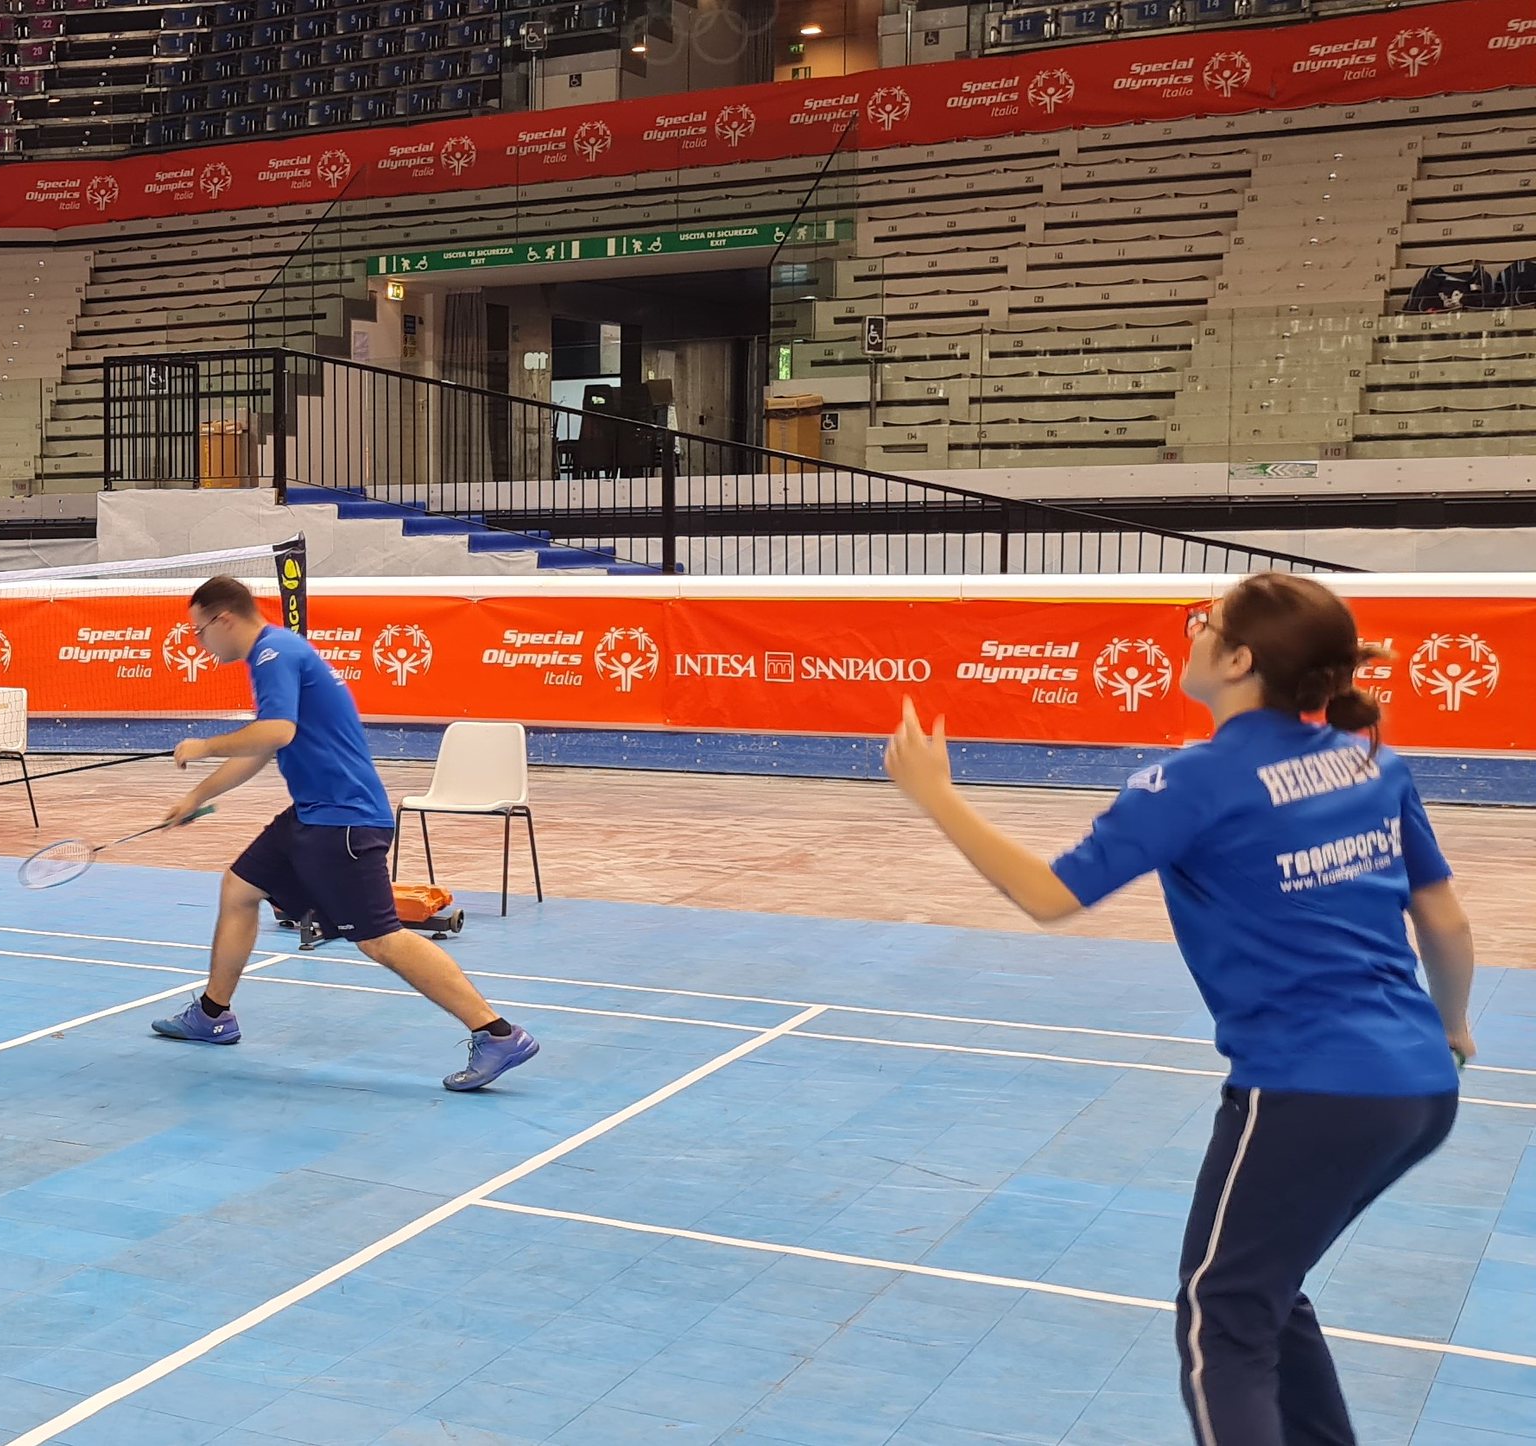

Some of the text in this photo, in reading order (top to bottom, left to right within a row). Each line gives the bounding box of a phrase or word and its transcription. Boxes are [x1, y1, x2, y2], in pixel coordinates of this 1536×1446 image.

[1082, 10, 1096, 24] 12
[1143, 3, 1158, 16] 13
[42, 19, 53, 29] 22
[1019, 19, 1031, 31] 11
[1308, 36, 1378, 57] Special
[1487, 35, 1536, 50] Olym
[32, 46, 43, 56] 20
[1129, 57, 1195, 76] Special
[1293, 54, 1377, 73] Olympics
[961, 75, 1020, 94] Special
[1114, 74, 1194, 92] Olympics
[803, 92, 860, 111] Special
[946, 93, 1019, 109] Olympics
[655, 110, 708, 128] Special
[517, 126, 567, 143] Special
[643, 126, 707, 142] Olympics
[388, 141, 435, 158] Special
[267, 154, 312, 170] Special
[377, 157, 434, 170] Olympics
[154, 167, 195, 182] Special
[257, 168, 311, 182] Olympics
[36, 178, 81, 191] Special
[145, 180, 194, 195] Olympics
[25, 191, 81, 202] Olympics
[679, 228, 758, 241] USCITA DI SICUREZZA
[710, 239, 727, 247] EXIT
[443, 251, 466, 259] USCITA
[477, 247, 513, 257] SICUREZZA
[77, 626, 152, 645] Special
[307, 627, 362, 641] ecial
[502, 629, 584, 648] Special
[58, 646, 152, 663] Olympics
[481, 649, 583, 668] Olympics
[980, 640, 1080, 661] Special
[116, 663, 153, 678] Italia
[674, 653, 932, 683] INTESA SANPAOLO
[956, 663, 1079, 684] Olympics
[543, 670, 583, 686] Italia
[1031, 686, 1079, 704] Italia
